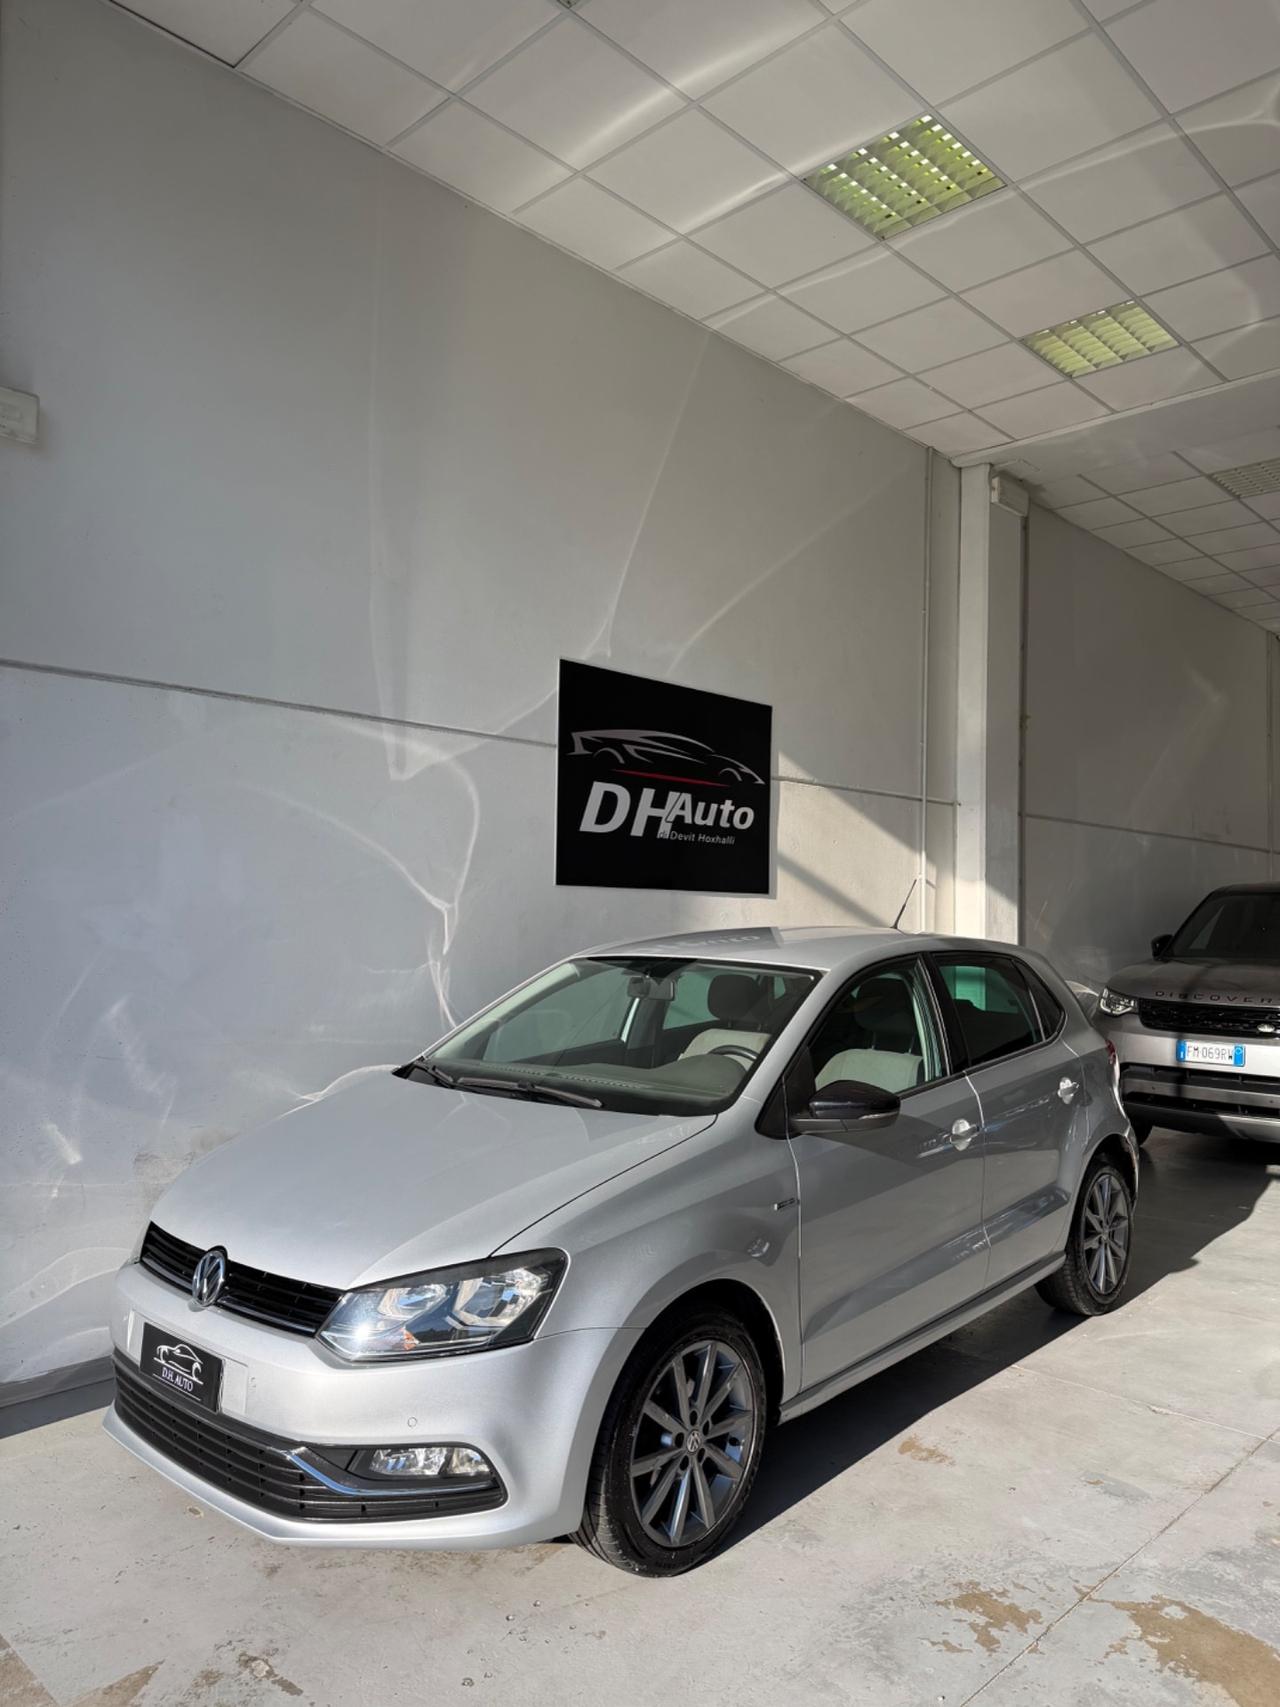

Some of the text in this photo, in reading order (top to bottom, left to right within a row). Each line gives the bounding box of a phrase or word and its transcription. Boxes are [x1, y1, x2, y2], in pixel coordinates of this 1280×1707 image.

[667, 792, 755, 830] Auto
[670, 831, 695, 842] Devit
[174, 1374, 194, 1392] AUTO
